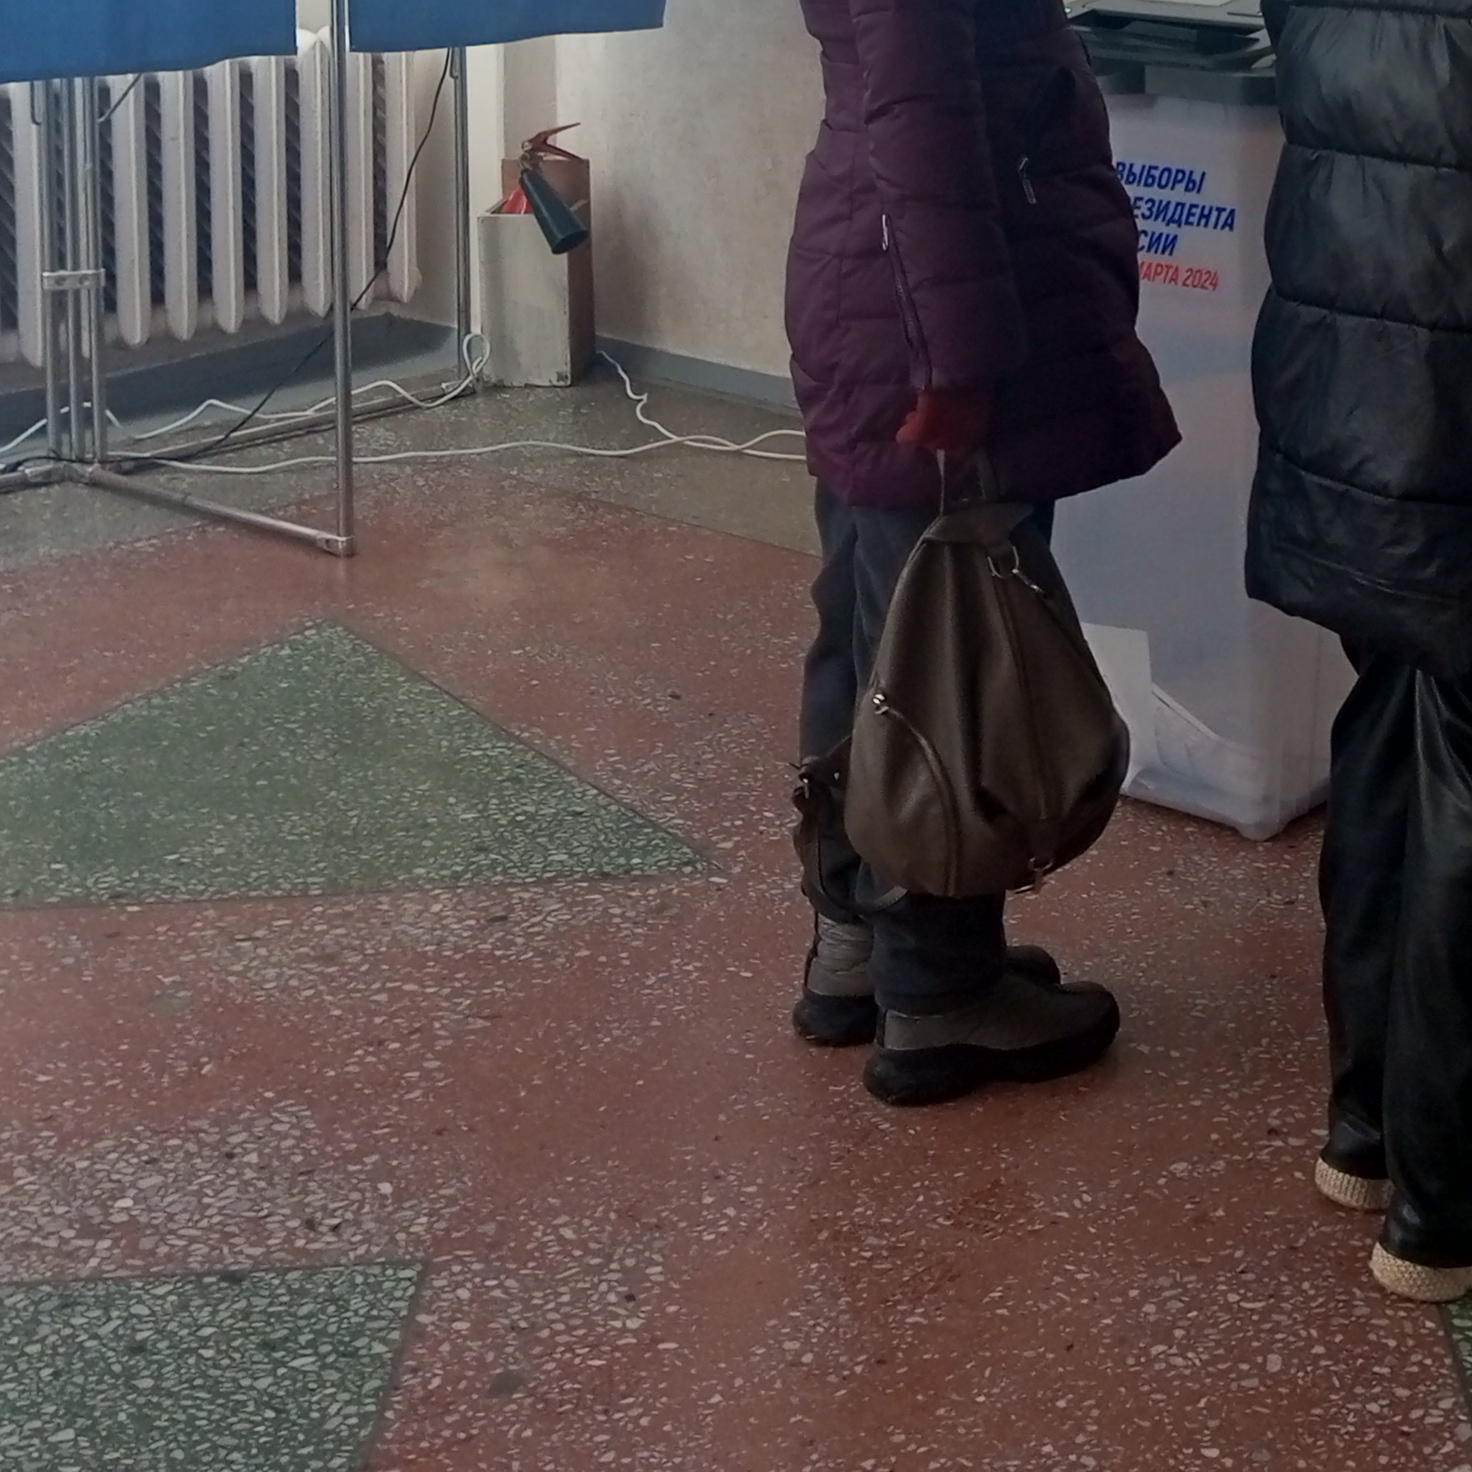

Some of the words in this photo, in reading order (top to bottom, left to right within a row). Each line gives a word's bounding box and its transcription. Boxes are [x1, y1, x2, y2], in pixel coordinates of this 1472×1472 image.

[1115, 161, 1206, 194] ВЫБОРЫ
[1132, 196, 1237, 232] ЕЗИДЕНТА
[1137, 230, 1179, 257] СИИ
[1182, 268, 1220, 292] 2024
